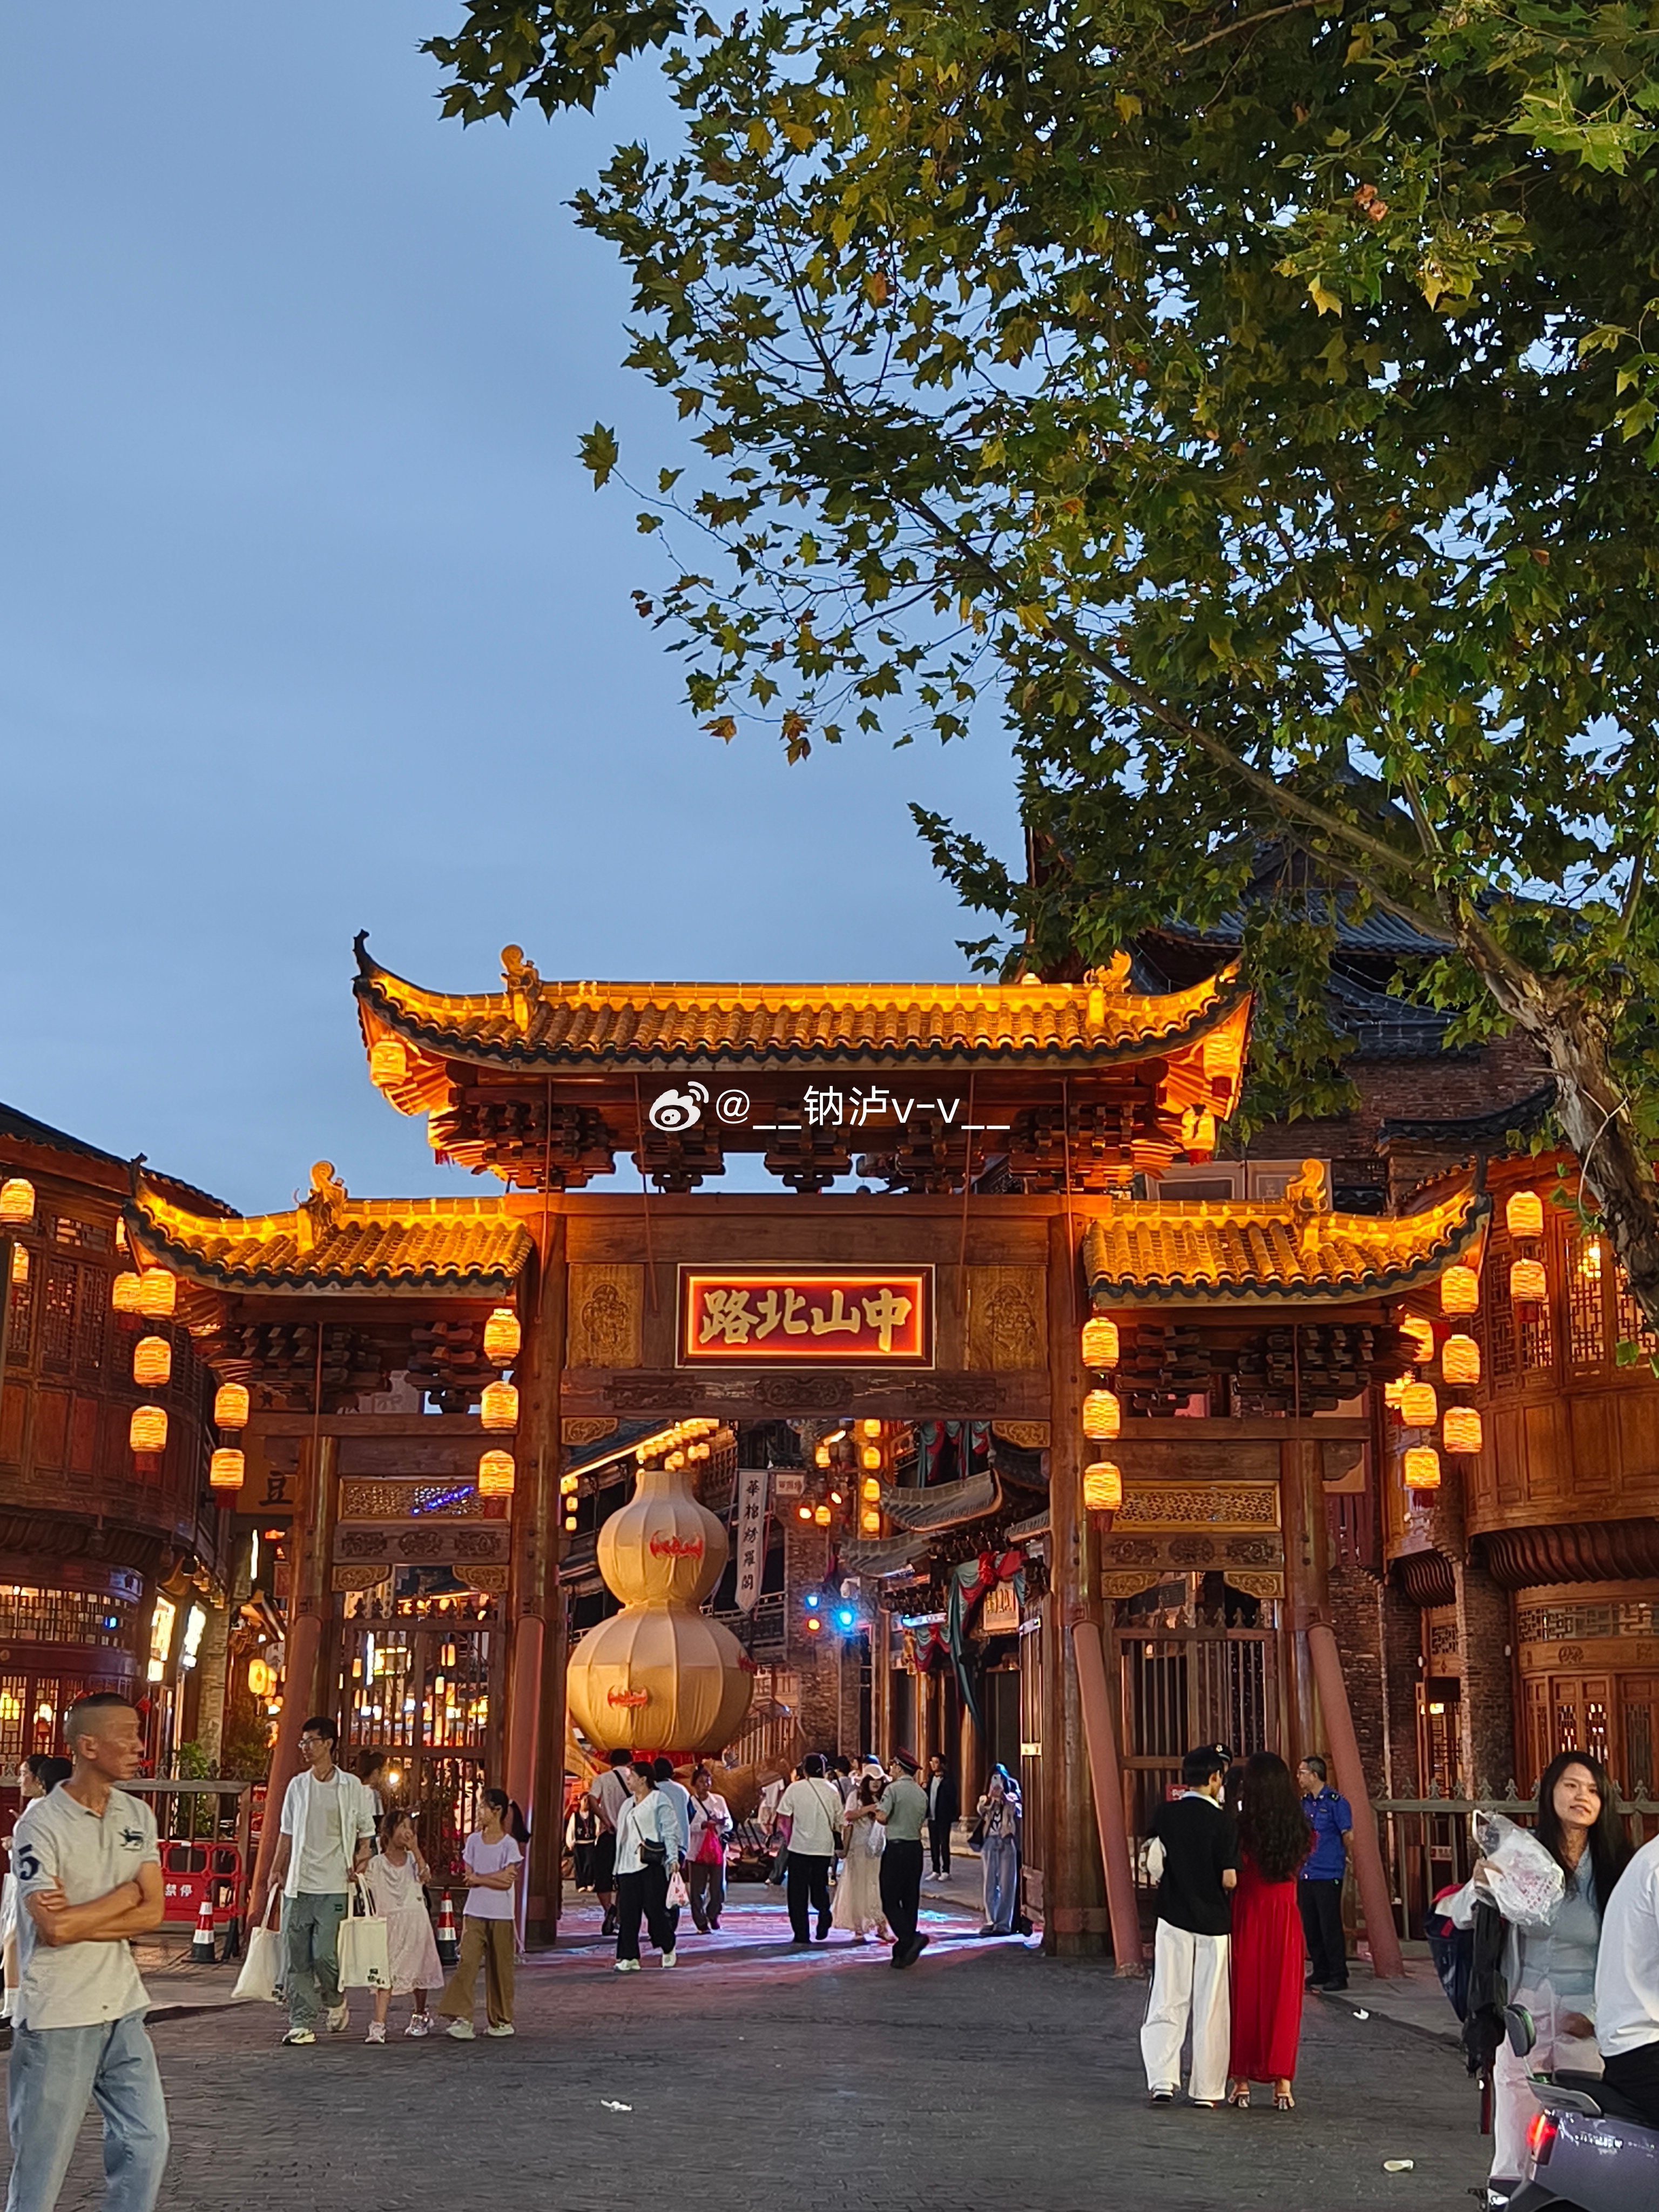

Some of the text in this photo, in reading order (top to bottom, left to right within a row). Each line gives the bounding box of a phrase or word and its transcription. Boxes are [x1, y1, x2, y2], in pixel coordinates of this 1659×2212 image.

[699, 1288, 912, 1352] 中山北路
[18, 1844, 40, 1880] 5
